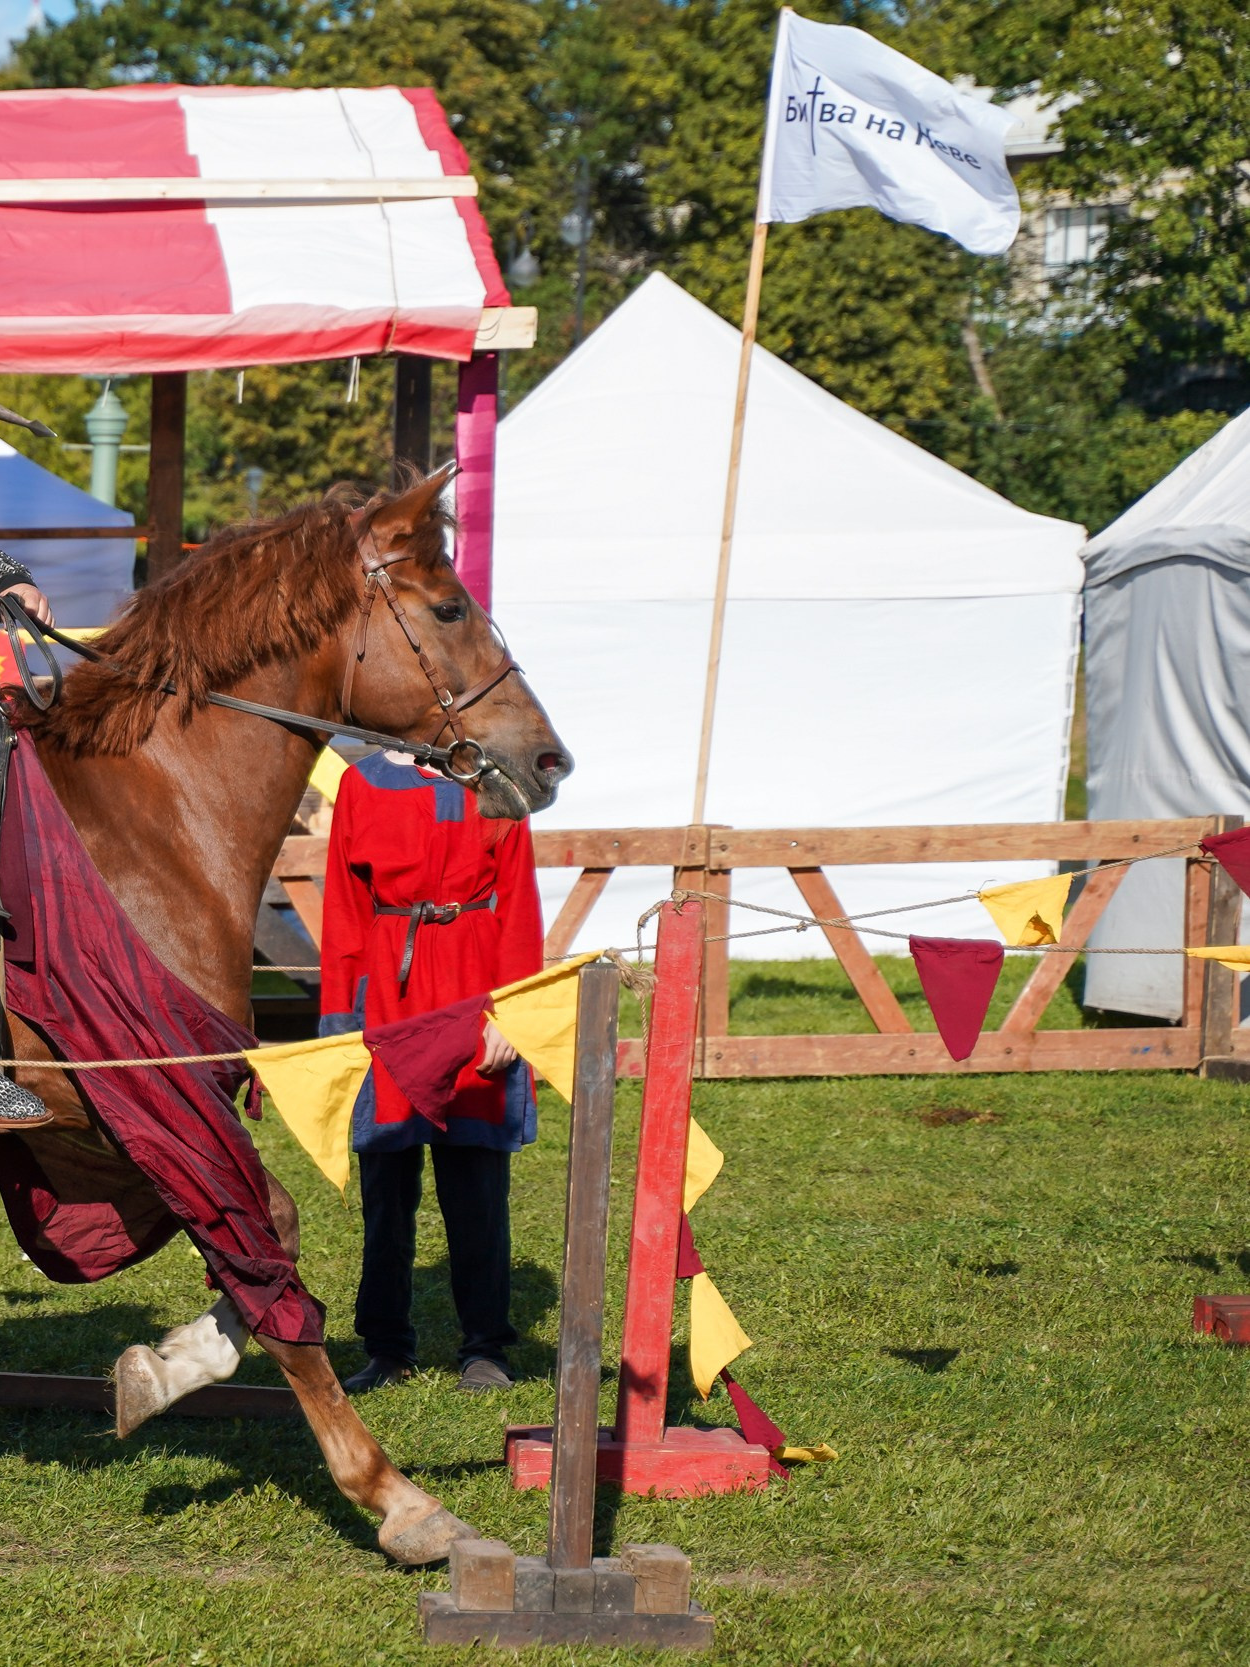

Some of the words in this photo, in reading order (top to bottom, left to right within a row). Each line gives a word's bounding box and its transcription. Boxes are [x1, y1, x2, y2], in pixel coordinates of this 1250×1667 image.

[785, 75, 857, 156] Битва
[865, 114, 906, 141] на
[915, 121, 982, 170] Неве
